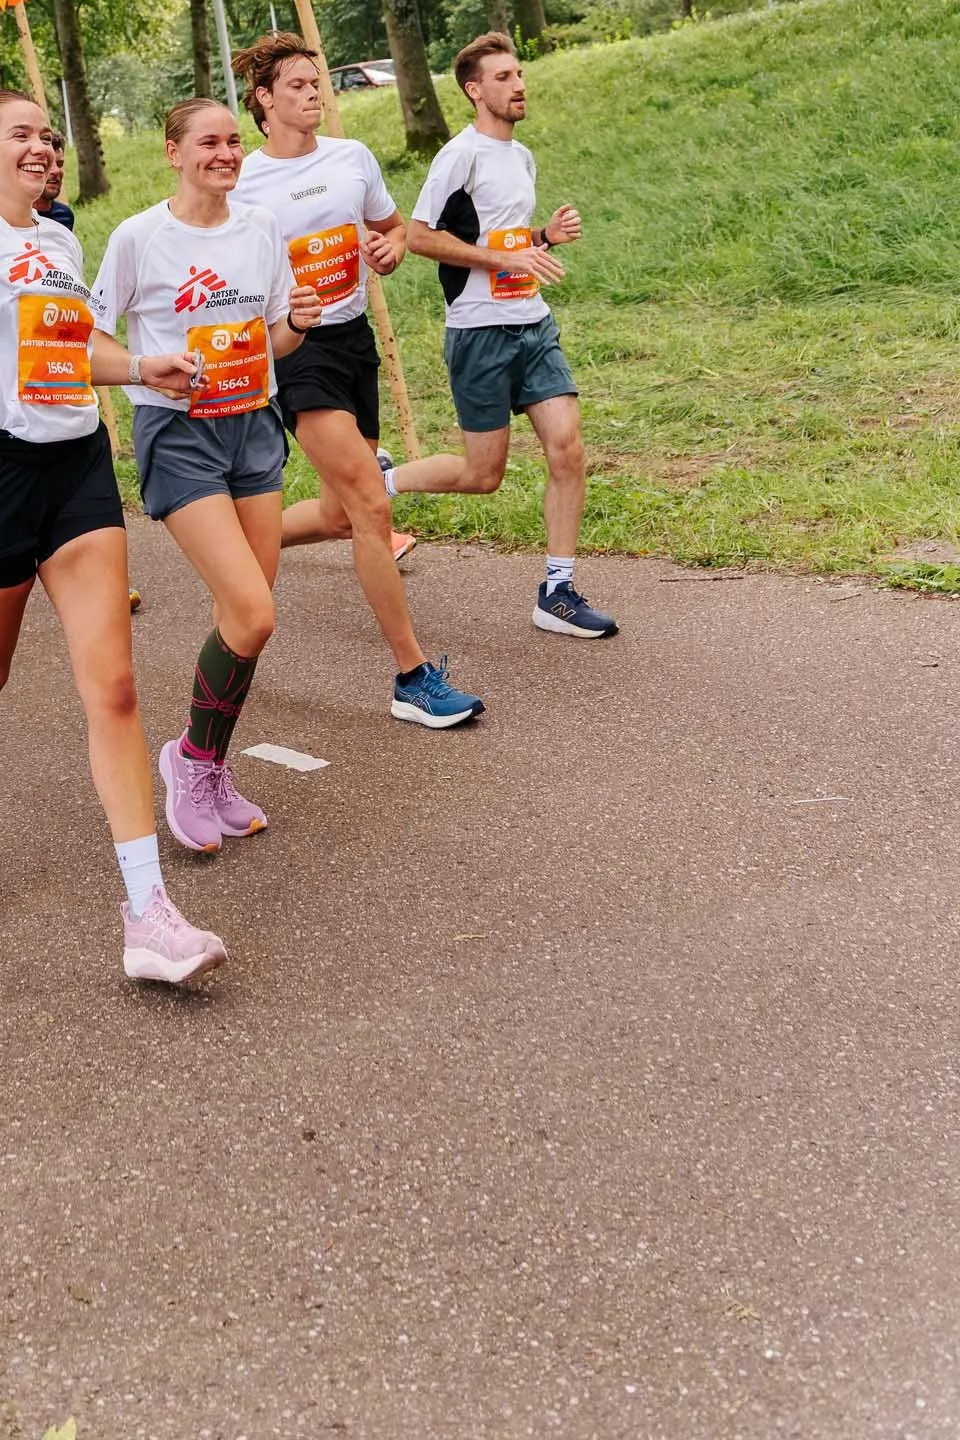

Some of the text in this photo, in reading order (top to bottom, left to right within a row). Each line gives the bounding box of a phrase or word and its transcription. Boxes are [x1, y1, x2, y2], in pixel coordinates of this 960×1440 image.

[324, 233, 344, 247] NN
[294, 254, 345, 276] INTERTOYS
[45, 270, 74, 282] ARTSEN
[316, 269, 348, 287] 22005
[41, 278, 73, 291] ZONDER
[210, 288, 239, 300] ARTSEN
[205, 297, 237, 309] ZONDER
[60, 309, 80, 323] NN
[232, 329, 252, 342] NN
[46, 361, 75, 375] 15642
[217, 375, 250, 392] 15643
[22, 393, 33, 401] NN
[204, 407, 219, 415] DAM
[220, 406, 231, 414] TOT
